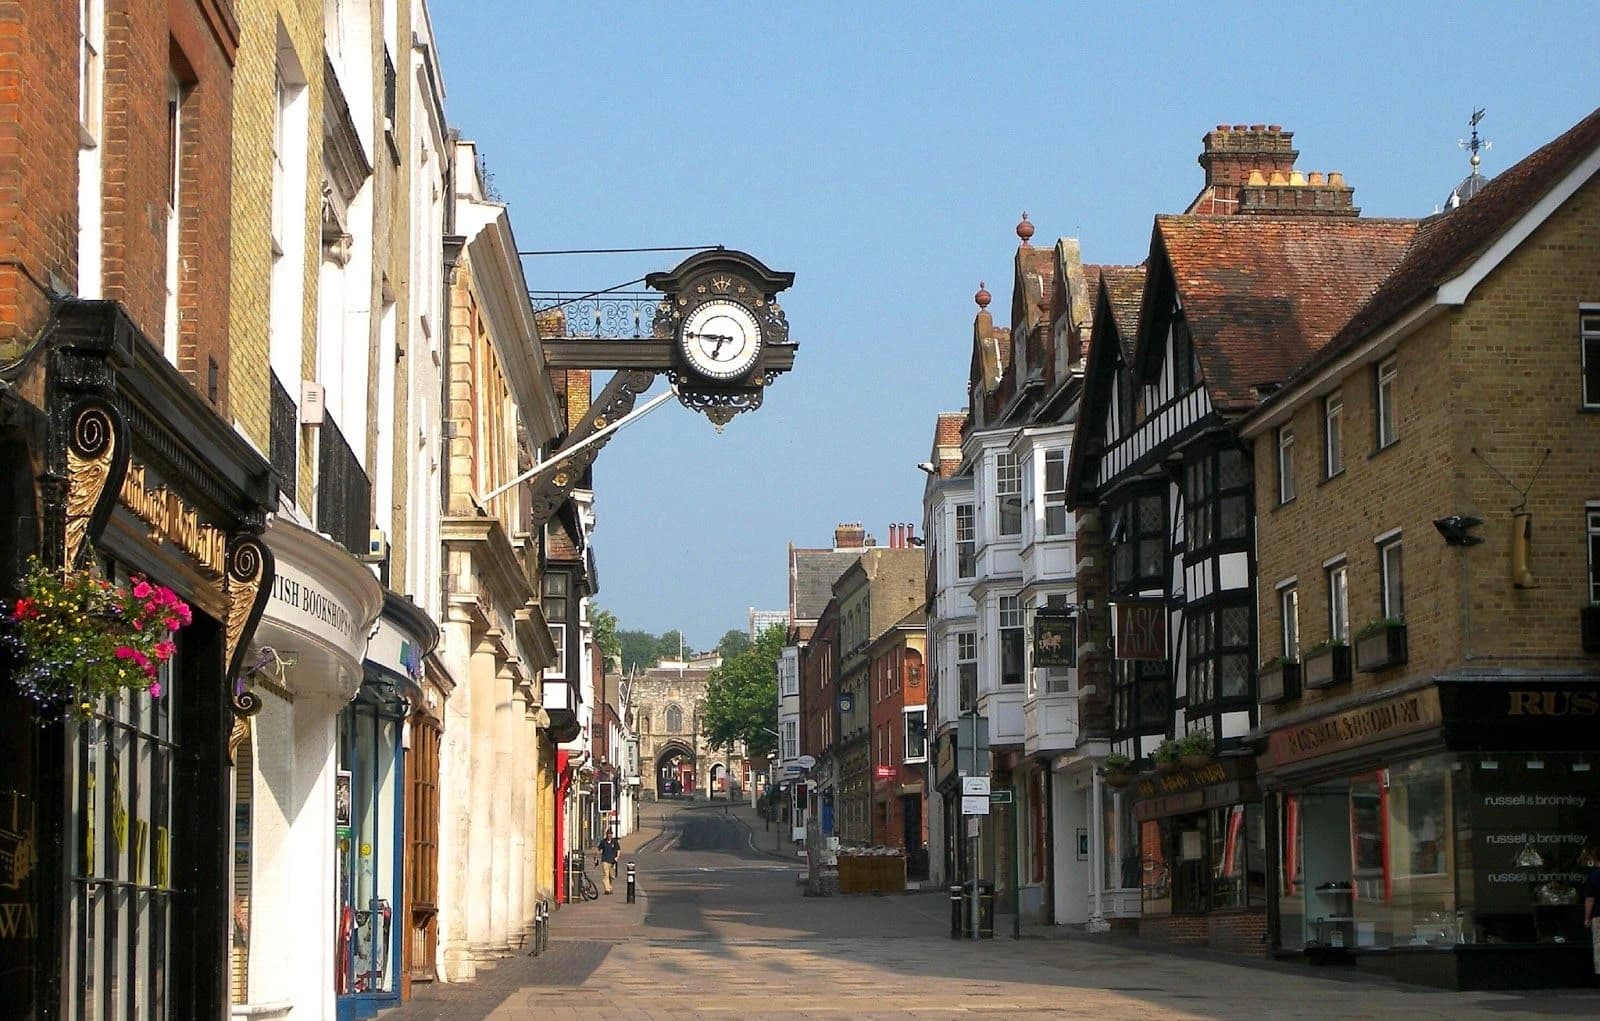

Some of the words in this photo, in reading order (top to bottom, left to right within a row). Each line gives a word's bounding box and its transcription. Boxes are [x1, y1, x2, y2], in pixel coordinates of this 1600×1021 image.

[1123, 607, 1161, 656] ASK
[1507, 691, 1599, 716] RUS
[1484, 794, 1525, 805] russell
[1527, 796, 1535, 805] &
[1536, 794, 1587, 807] bromley
[1486, 832, 1526, 844] russell
[1528, 834, 1535, 844] &
[1537, 832, 1588, 845] bromley
[1488, 872, 1527, 882] russell
